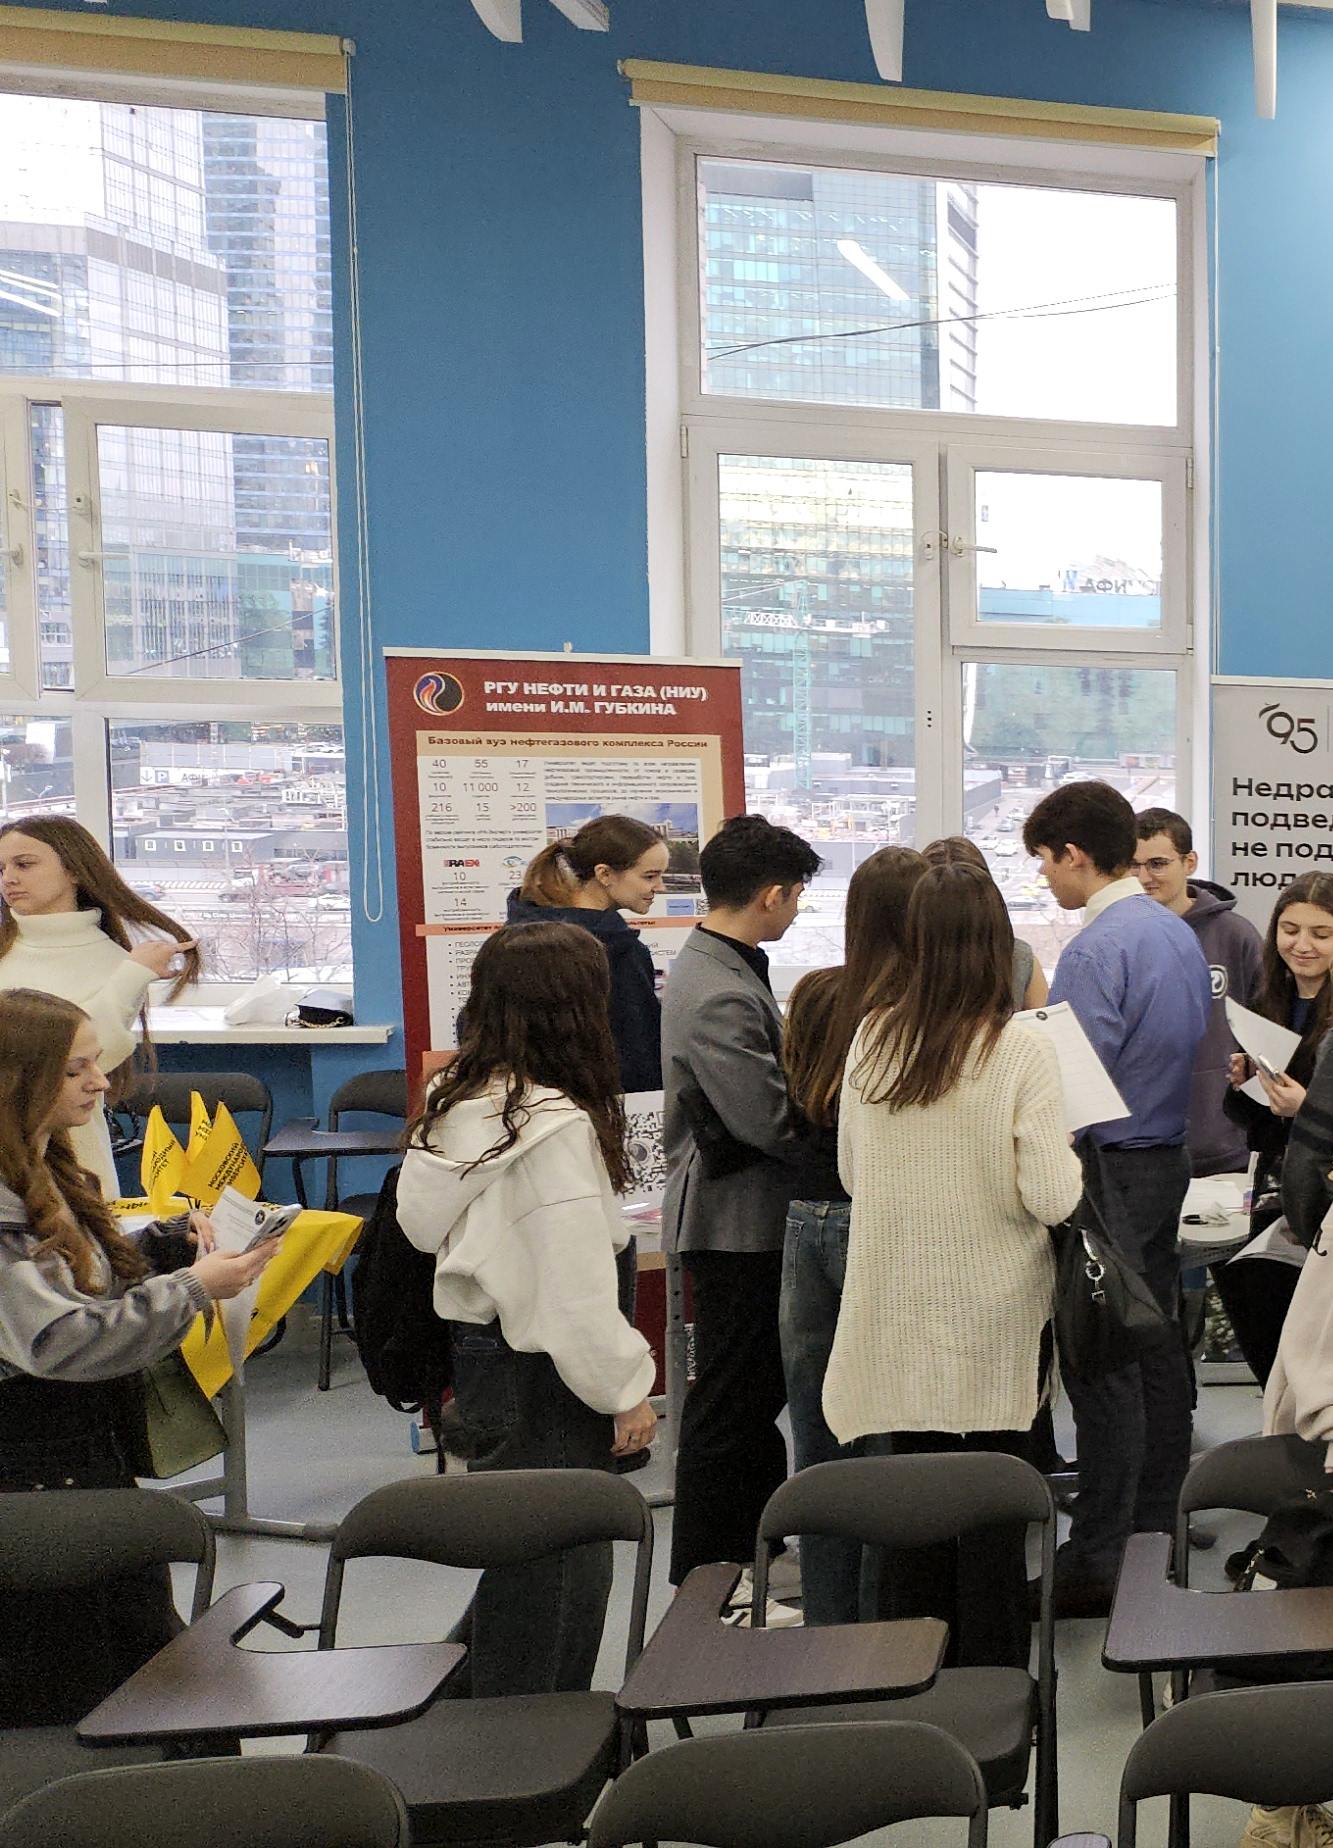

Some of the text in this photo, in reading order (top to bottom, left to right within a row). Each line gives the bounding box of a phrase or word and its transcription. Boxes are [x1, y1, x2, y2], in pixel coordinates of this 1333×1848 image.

[484, 681, 708, 701] РГУ НЕФТИ И ГАЗА (НИУ)
[486, 700, 677, 716] имени И.М. ГУБКИНА
[427, 735, 708, 748] Базовый вуз нефтегазового комплекса России
[432, 759, 529, 769] 40 55 17
[433, 783, 529, 792] 10 11 000 12
[431, 803, 537, 812] 216 15 >200
[1231, 841, 1268, 857] не
[453, 870, 522, 881] 10 23
[1230, 872, 1296, 891] люд
[454, 898, 467, 907] 14
